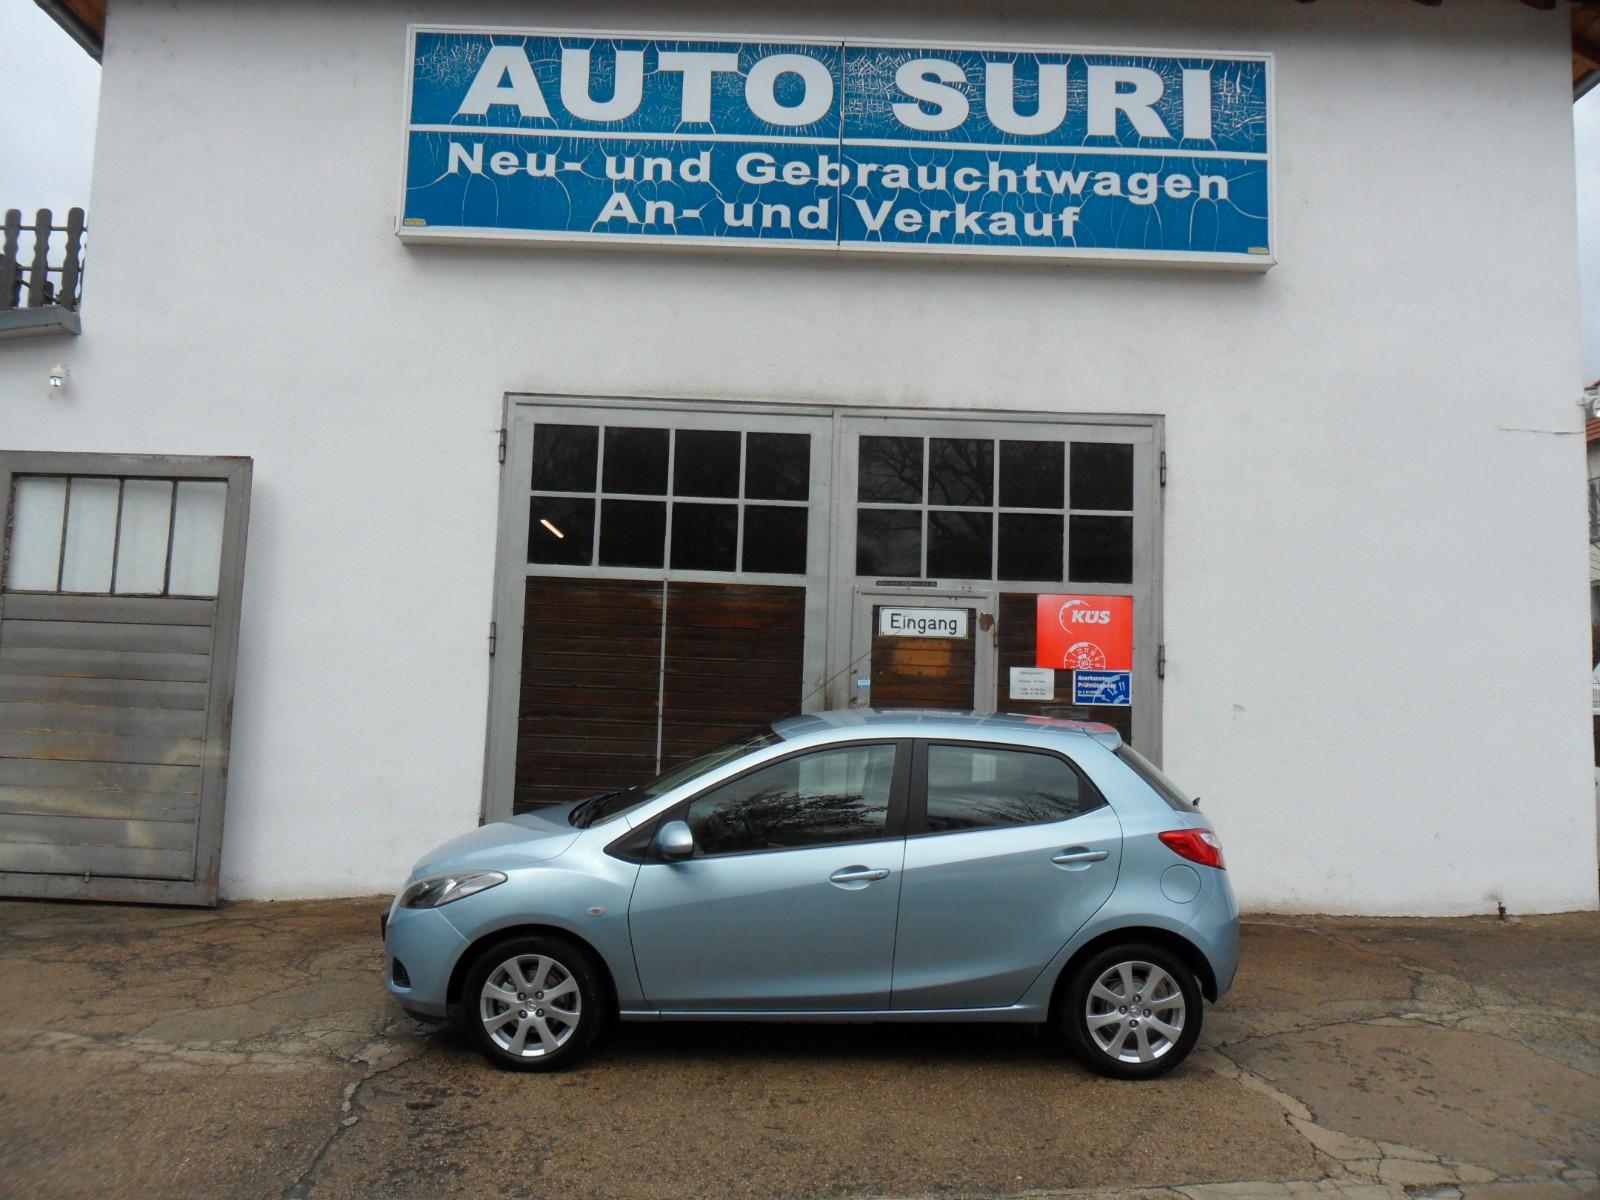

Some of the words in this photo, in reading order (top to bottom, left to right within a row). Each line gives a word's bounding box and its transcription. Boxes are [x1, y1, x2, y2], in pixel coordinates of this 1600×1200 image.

[456, 44, 835, 128] AUTO
[891, 57, 1213, 141] SURI
[447, 142, 583, 178] Neu-
[605, 151, 712, 183] und
[735, 152, 1229, 206] Gebrauchtwagen
[597, 191, 703, 226] An-
[723, 198, 830, 231] und
[856, 199, 1080, 239] Verkauf
[890, 613, 958, 635] Eingang
[1071, 609, 1111, 625] KÜS
